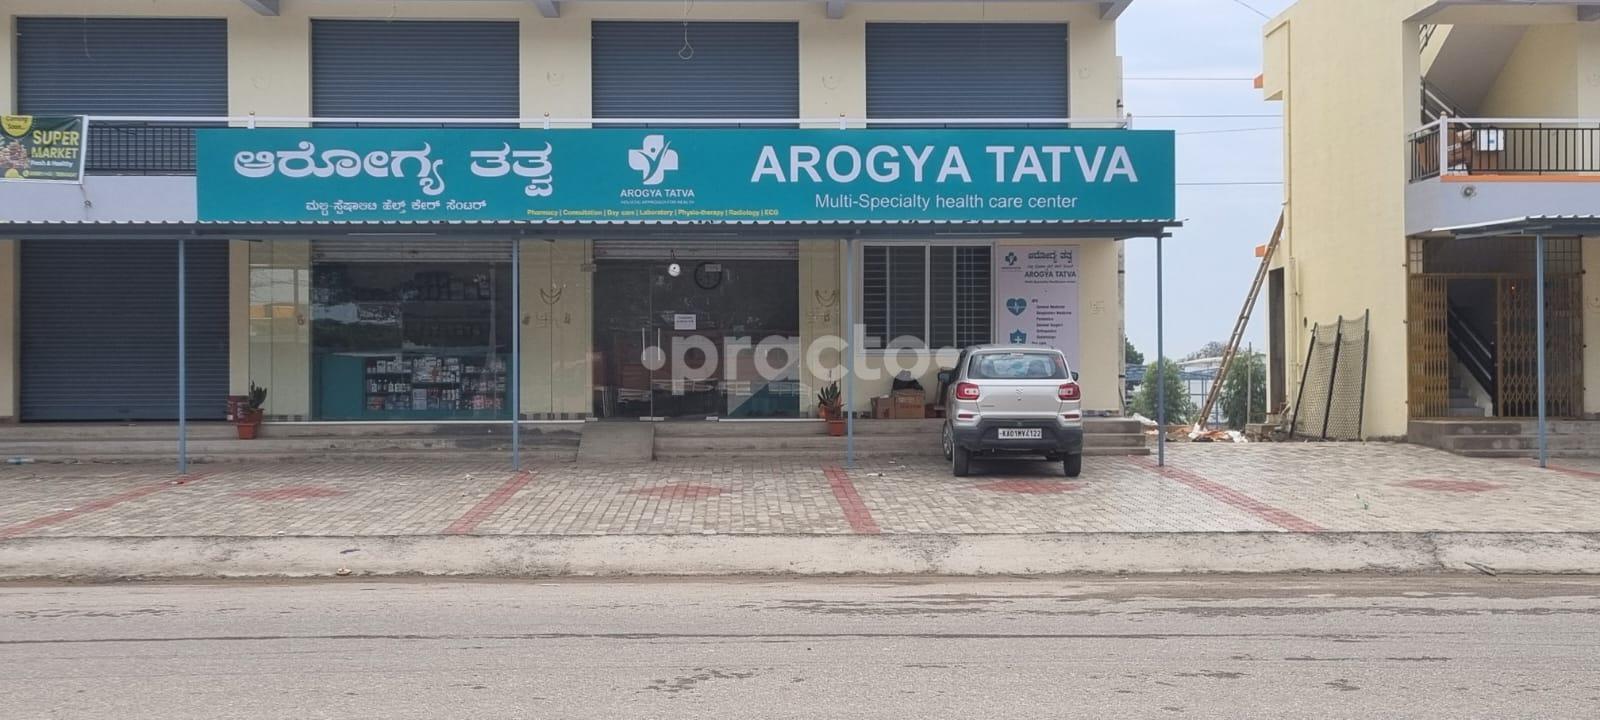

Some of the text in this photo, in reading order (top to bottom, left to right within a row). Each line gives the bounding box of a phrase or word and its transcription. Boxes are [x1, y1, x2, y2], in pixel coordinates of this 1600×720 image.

[32, 130, 79, 146] SUPER
[31, 147, 79, 159] MARKET
[234, 140, 553, 197] ಆರೋಗ್ಯ ತತ್ವ
[750, 144, 1139, 184] AROGYA TATVA
[620, 188, 695, 198] AROGYA TATVA
[815, 194, 1078, 211] Multi-Specialty health care center
[527, 209, 558, 217] Pharmacy
[640, 209, 673, 217] Laboratory
[678, 209, 724, 217] Physio-therapy
[729, 209, 759, 217] Radiology
